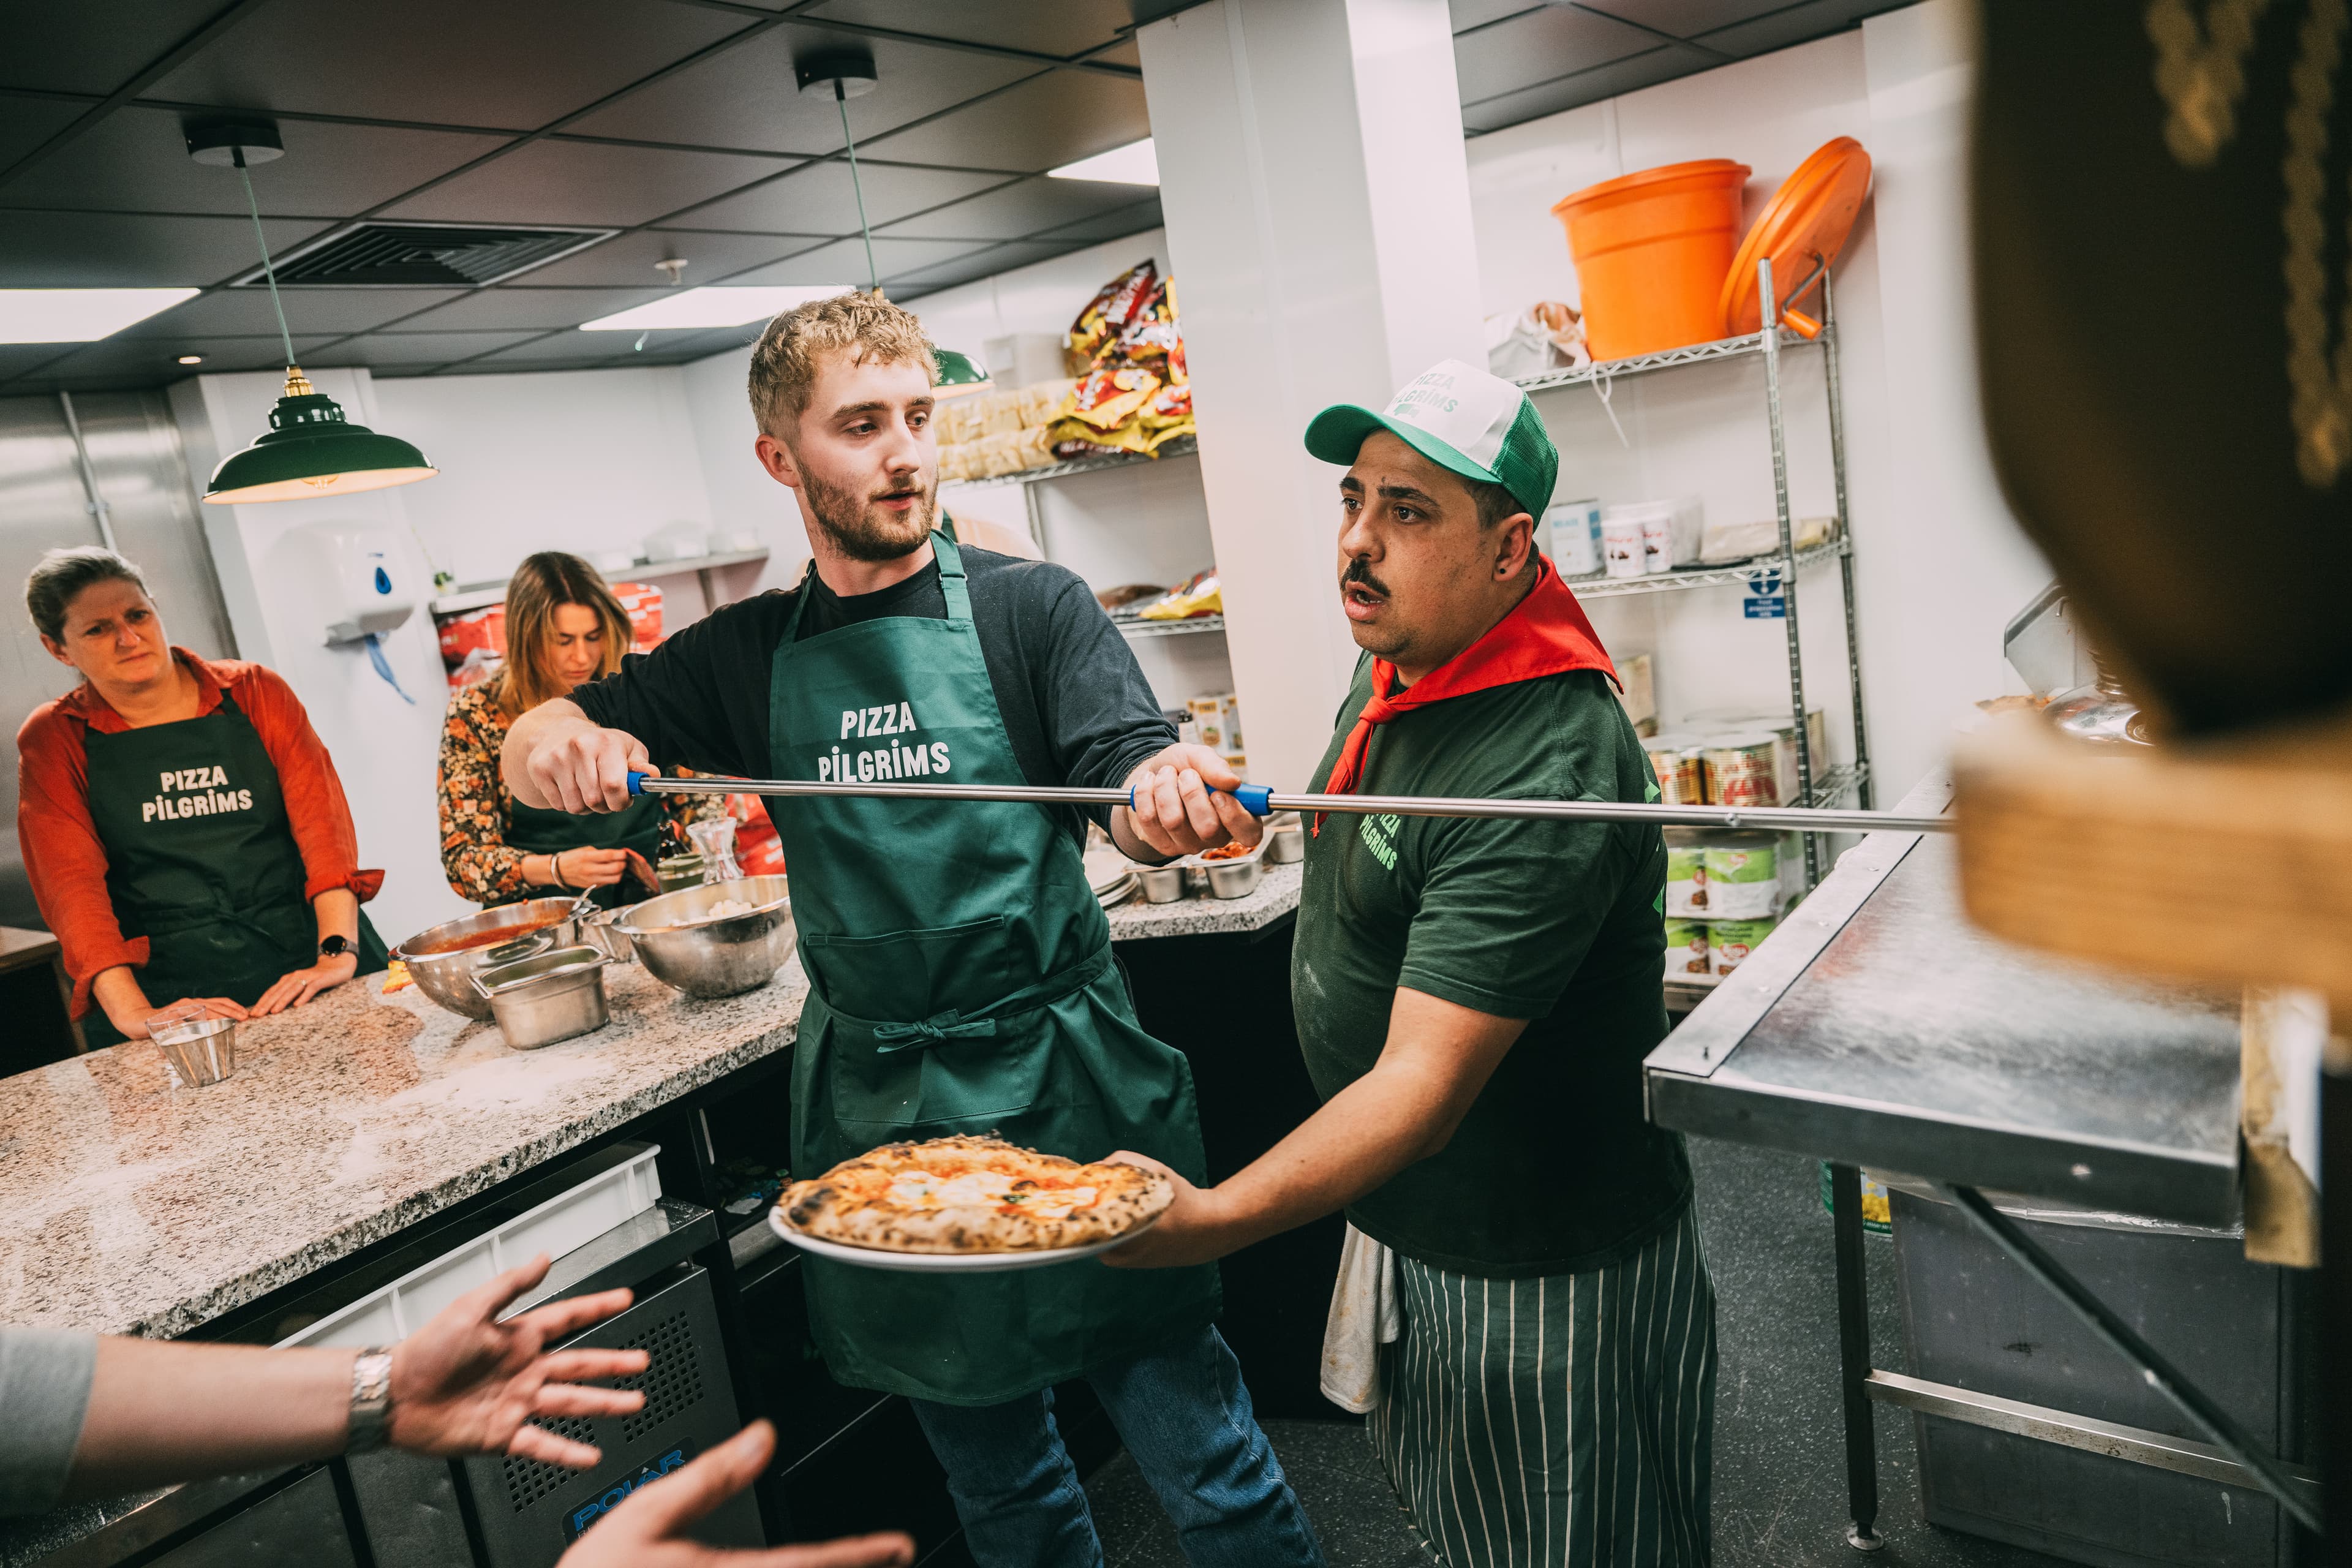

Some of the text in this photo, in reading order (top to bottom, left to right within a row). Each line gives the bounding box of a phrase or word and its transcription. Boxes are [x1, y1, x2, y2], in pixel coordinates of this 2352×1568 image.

[841, 701, 916, 739] PIZZA
[160, 766, 228, 793] PIZZA
[1376, 813, 1401, 839] ZZA
[573, 1450, 685, 1531] POLAR
